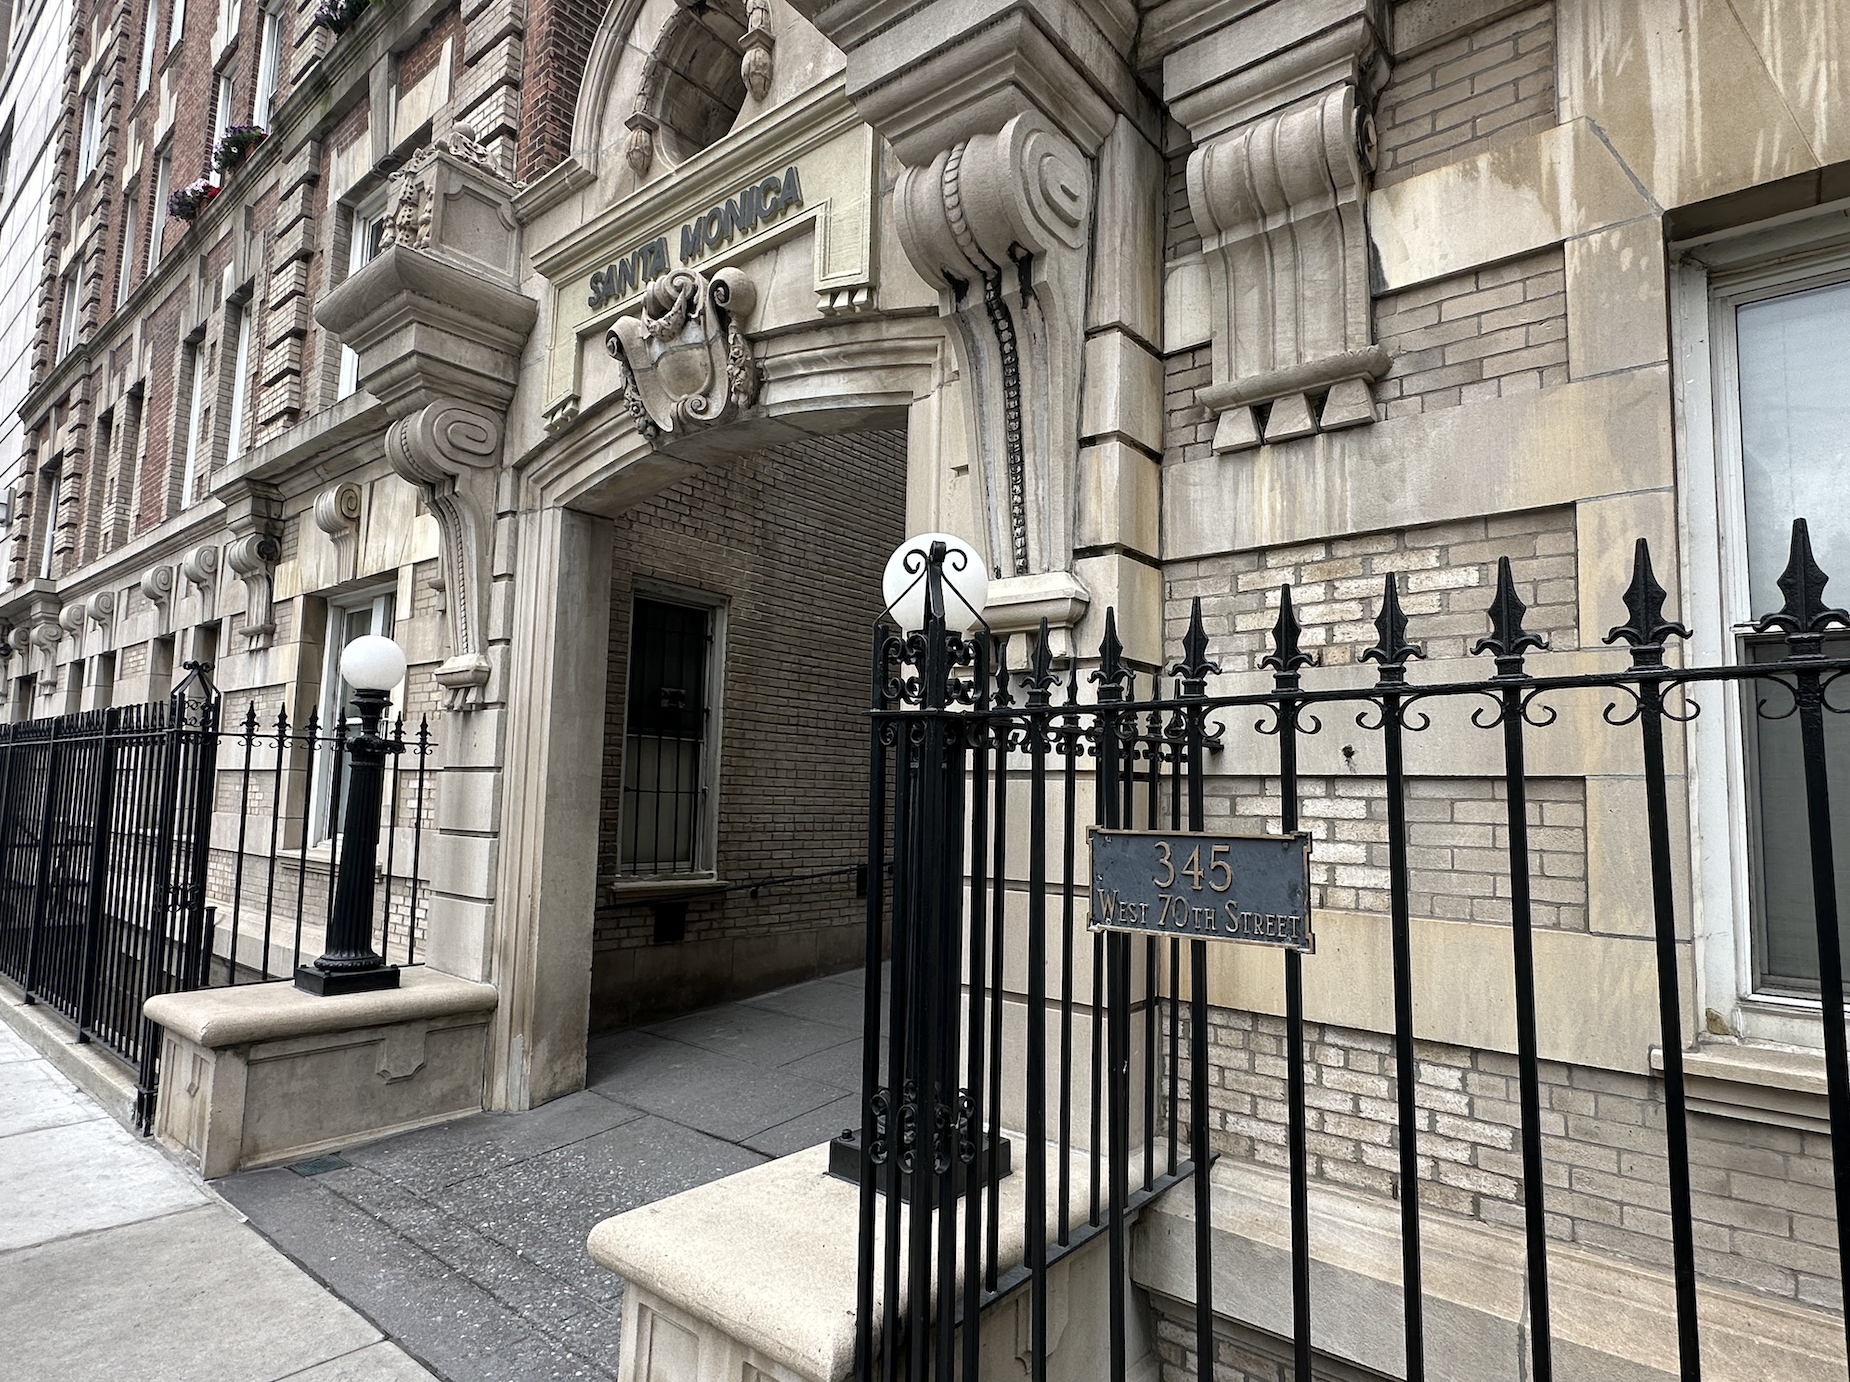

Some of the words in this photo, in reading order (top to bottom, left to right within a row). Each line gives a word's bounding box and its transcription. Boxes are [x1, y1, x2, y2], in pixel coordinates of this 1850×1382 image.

[588, 237, 670, 309] SANTA
[680, 166, 803, 264] MONICA
[1153, 841, 1233, 892] 345
